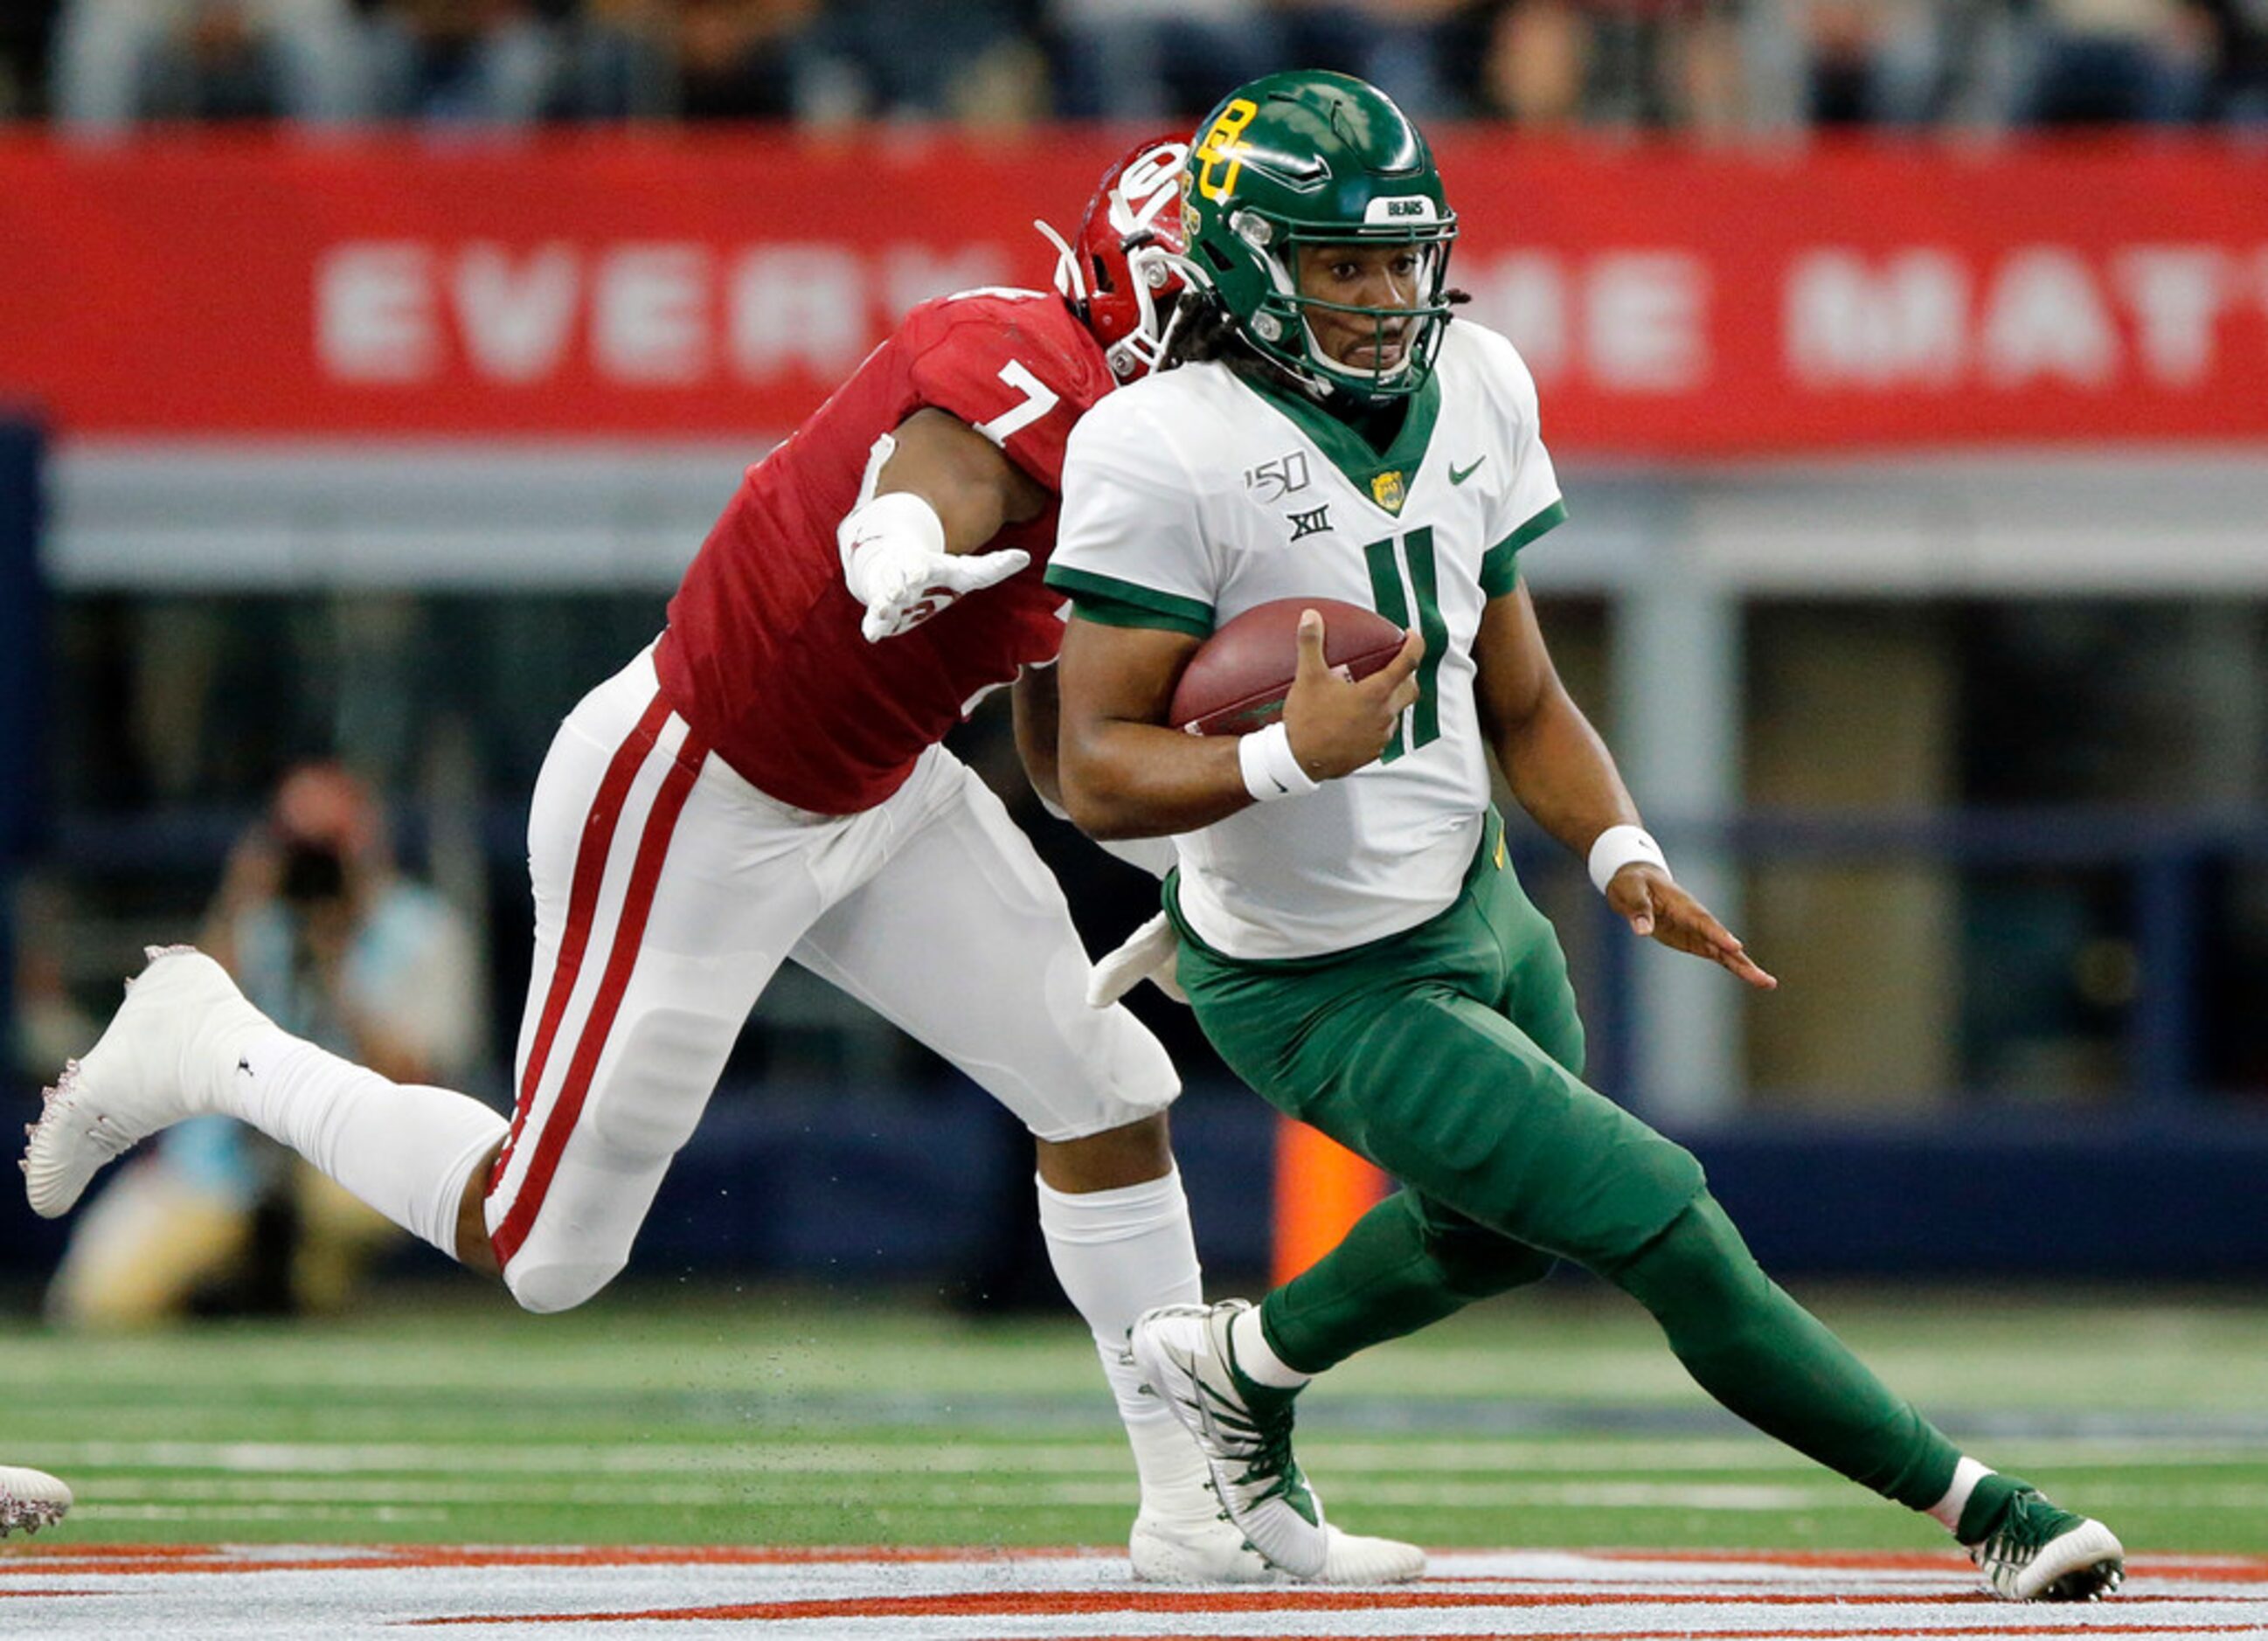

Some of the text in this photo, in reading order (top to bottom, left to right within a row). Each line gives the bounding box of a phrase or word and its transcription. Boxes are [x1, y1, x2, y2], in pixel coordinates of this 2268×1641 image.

[1387, 200, 1425, 218] BEARS
[972, 358, 1060, 448] 7
[1363, 525, 1449, 765] 11
